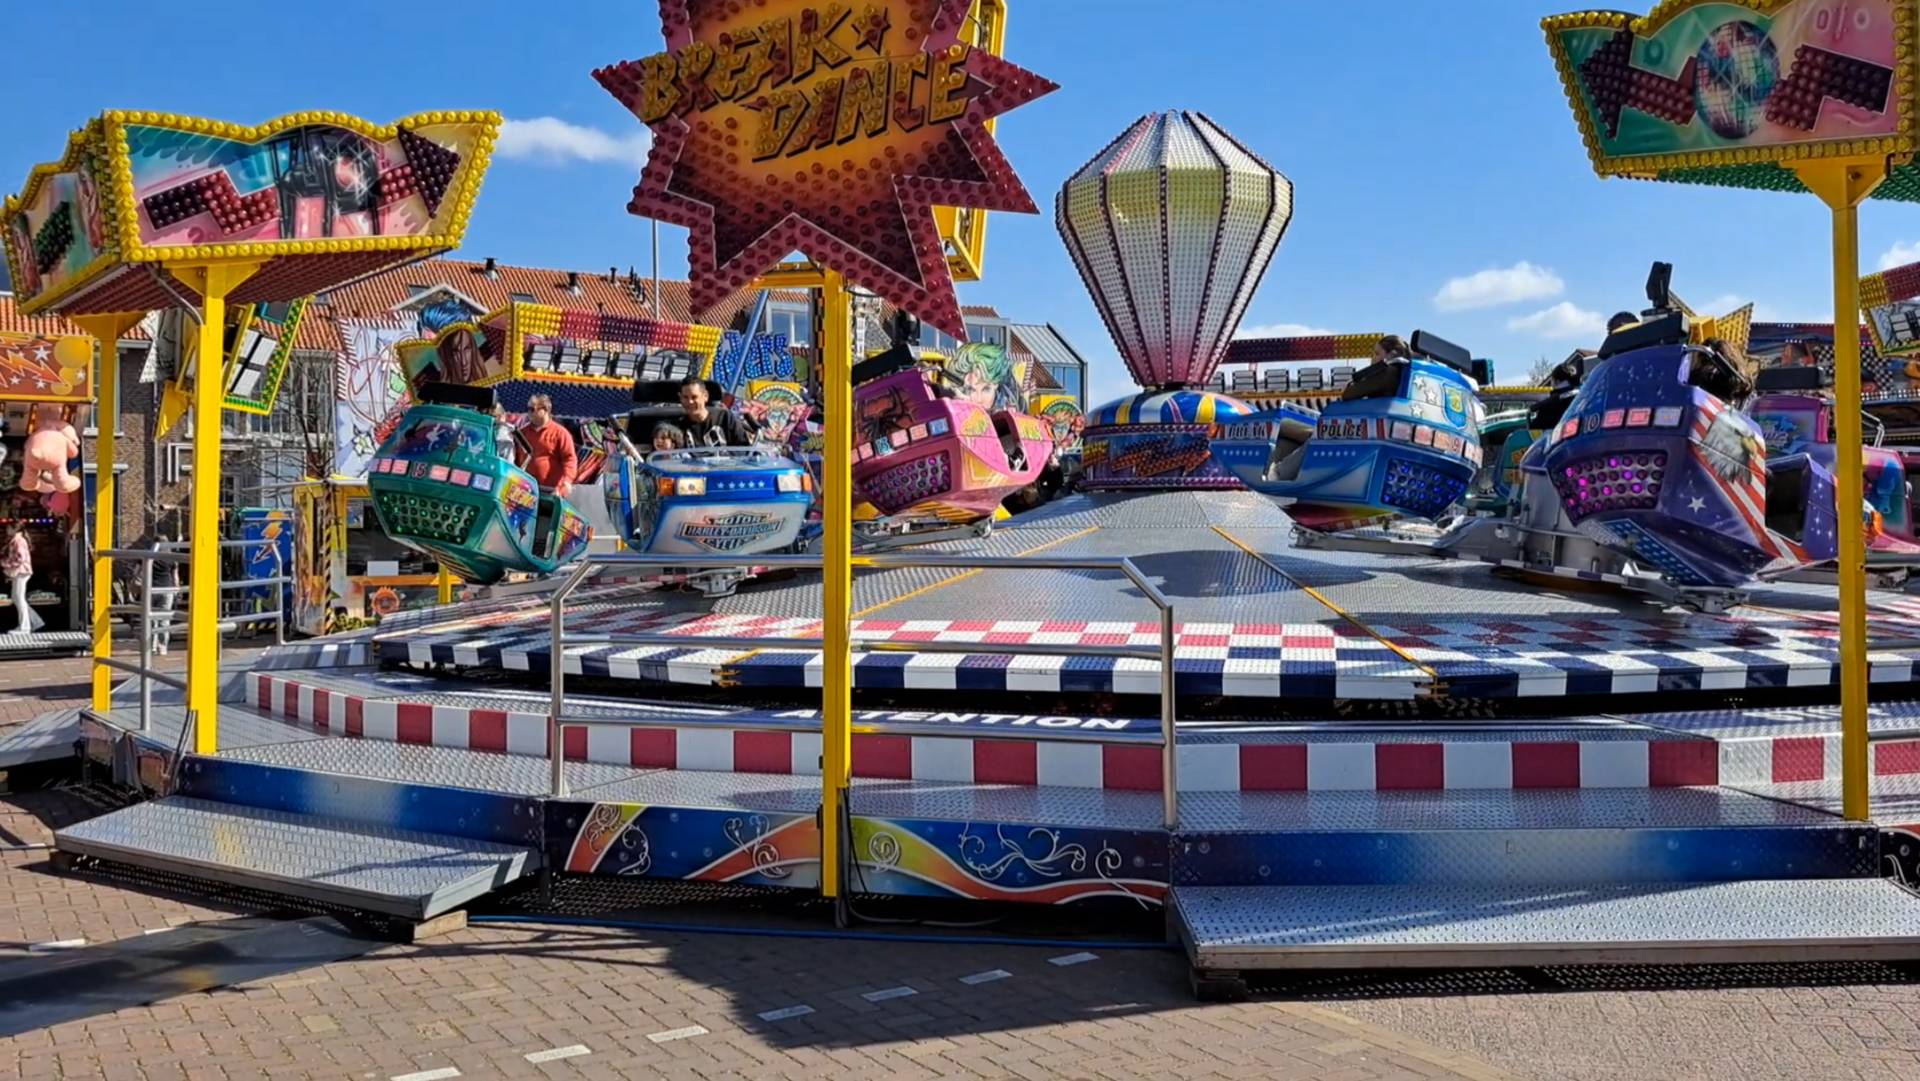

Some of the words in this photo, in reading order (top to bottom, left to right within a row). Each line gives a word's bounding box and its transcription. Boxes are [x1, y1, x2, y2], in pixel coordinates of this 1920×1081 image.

[642, 4, 852, 123] BREAK
[748, 42, 972, 163] DANCE
[1228, 424, 1266, 438] BREAK
[1320, 424, 1363, 437] POLICE
[714, 514, 766, 524] MOTOR
[771, 709, 1131, 729] ATENTION
